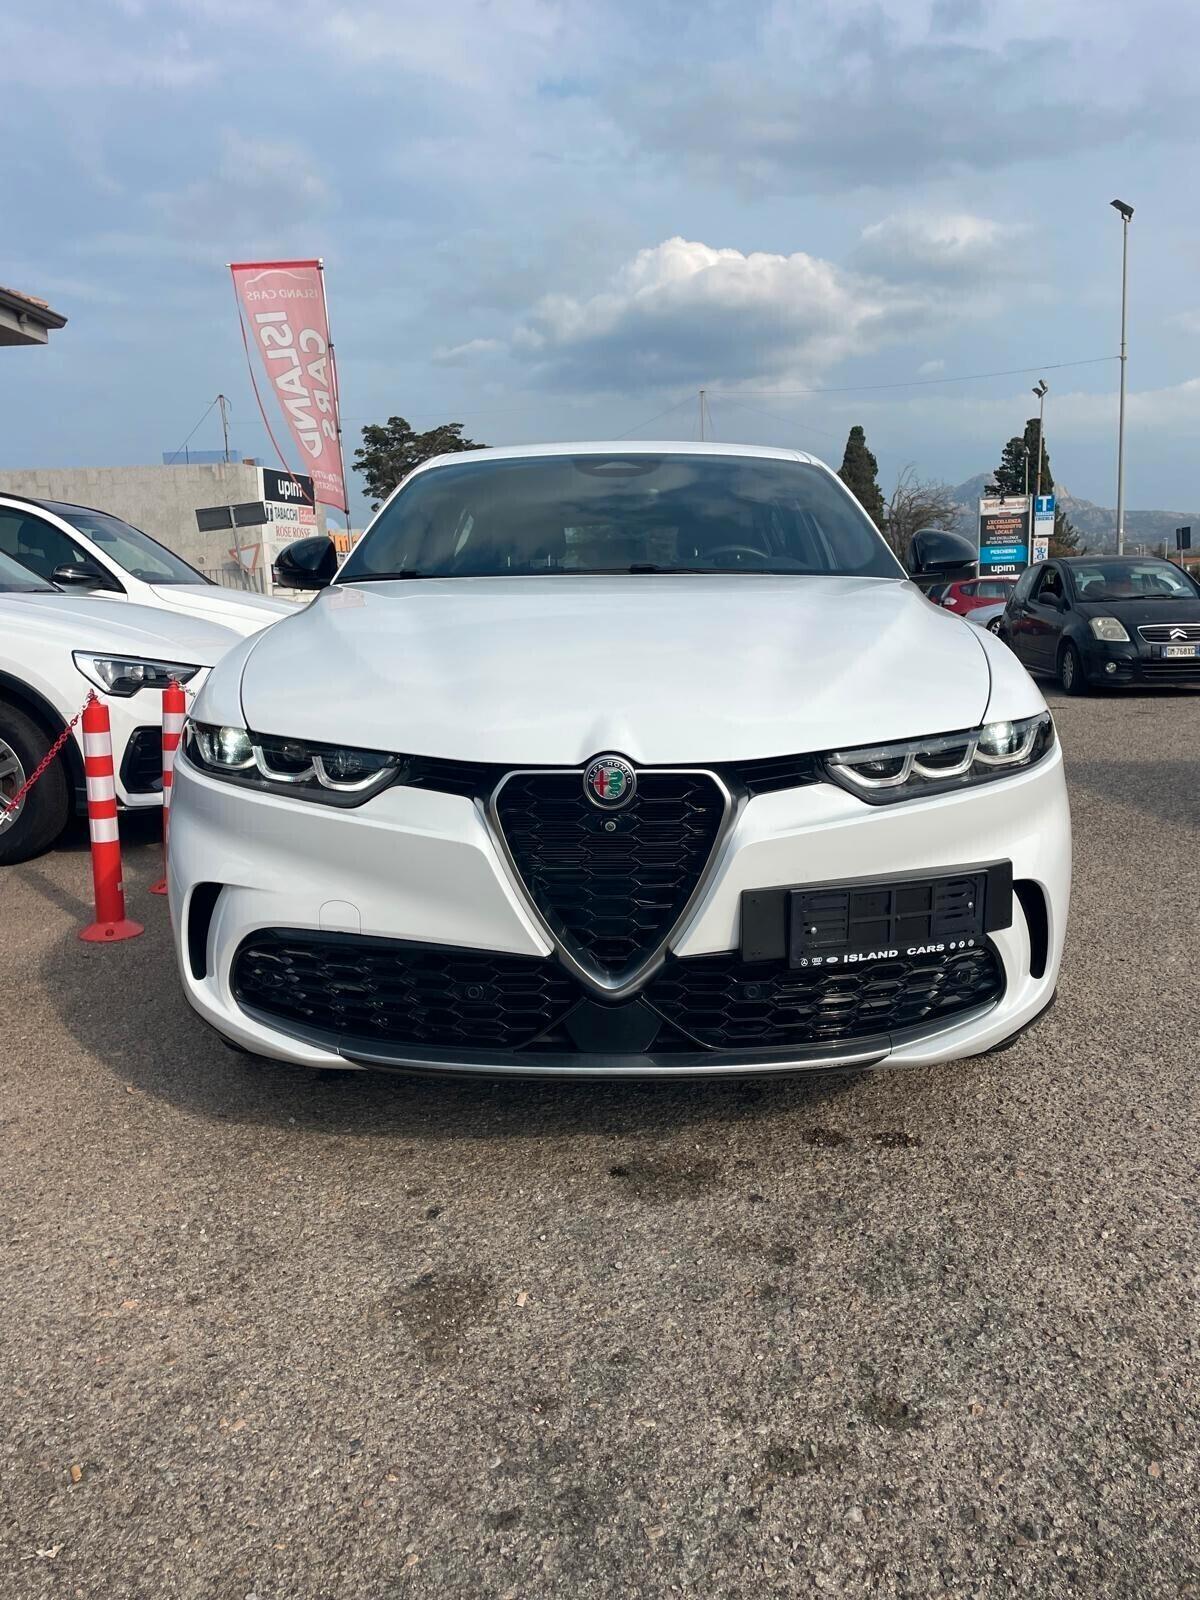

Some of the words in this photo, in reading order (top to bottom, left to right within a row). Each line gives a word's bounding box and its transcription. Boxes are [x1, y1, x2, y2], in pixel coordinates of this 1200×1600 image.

[277, 479, 303, 500] upim
[274, 506, 297, 521] TABACCHI
[275, 525, 294, 537] ROSE
[294, 526, 312, 538] ROSSE
[991, 564, 1016, 574] upim
[589, 764, 604, 784] ALFA
[607, 761, 632, 784] ROMEO
[843, 949, 899, 963] ISLAND
[906, 943, 945, 956] CARS
